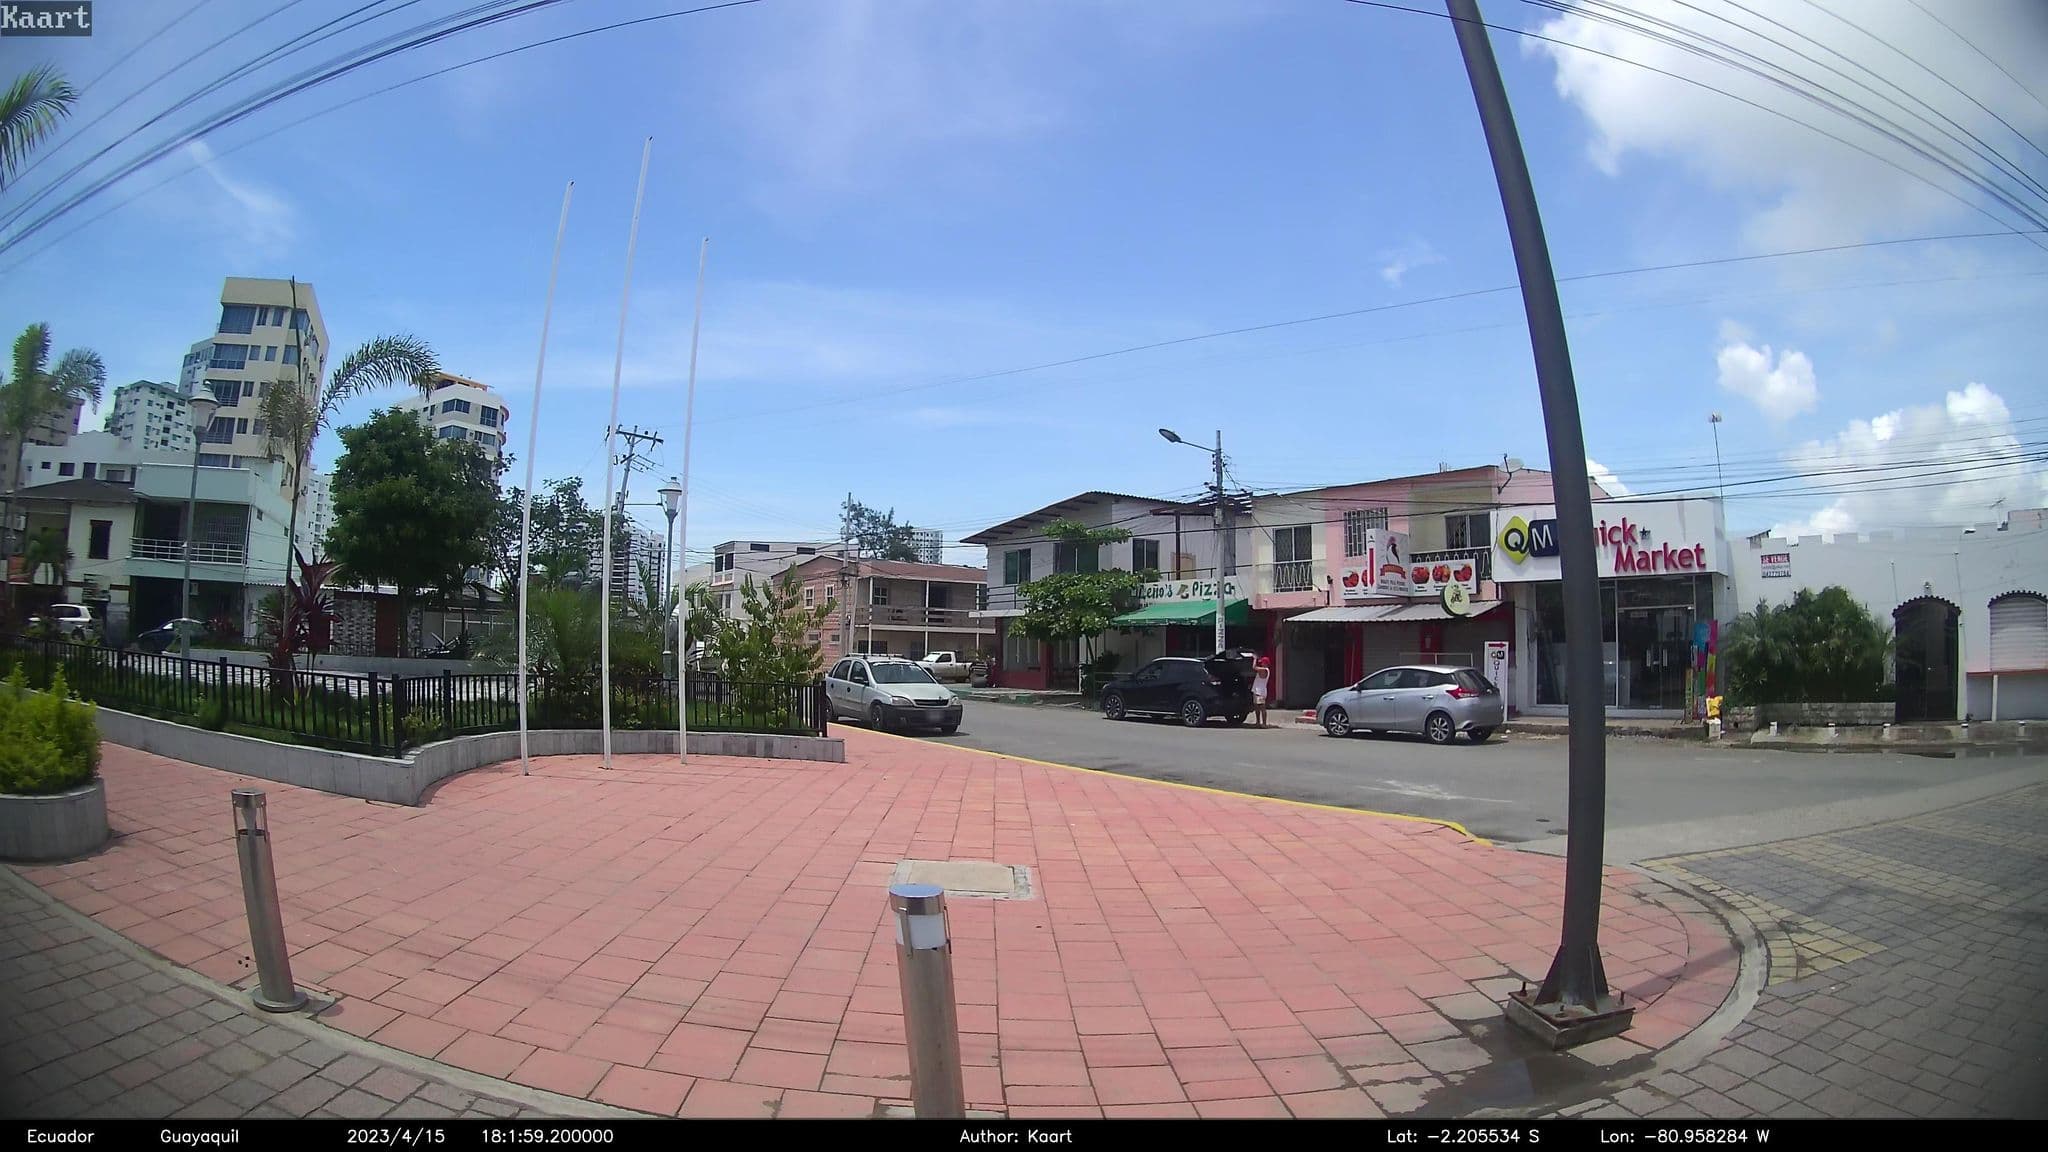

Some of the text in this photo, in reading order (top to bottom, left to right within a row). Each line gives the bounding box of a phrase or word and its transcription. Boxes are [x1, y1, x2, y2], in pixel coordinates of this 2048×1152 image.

[1593, 517, 1637, 546] ick
[1614, 542, 1706, 573] Market
[1192, 581, 1235, 597] Piza
